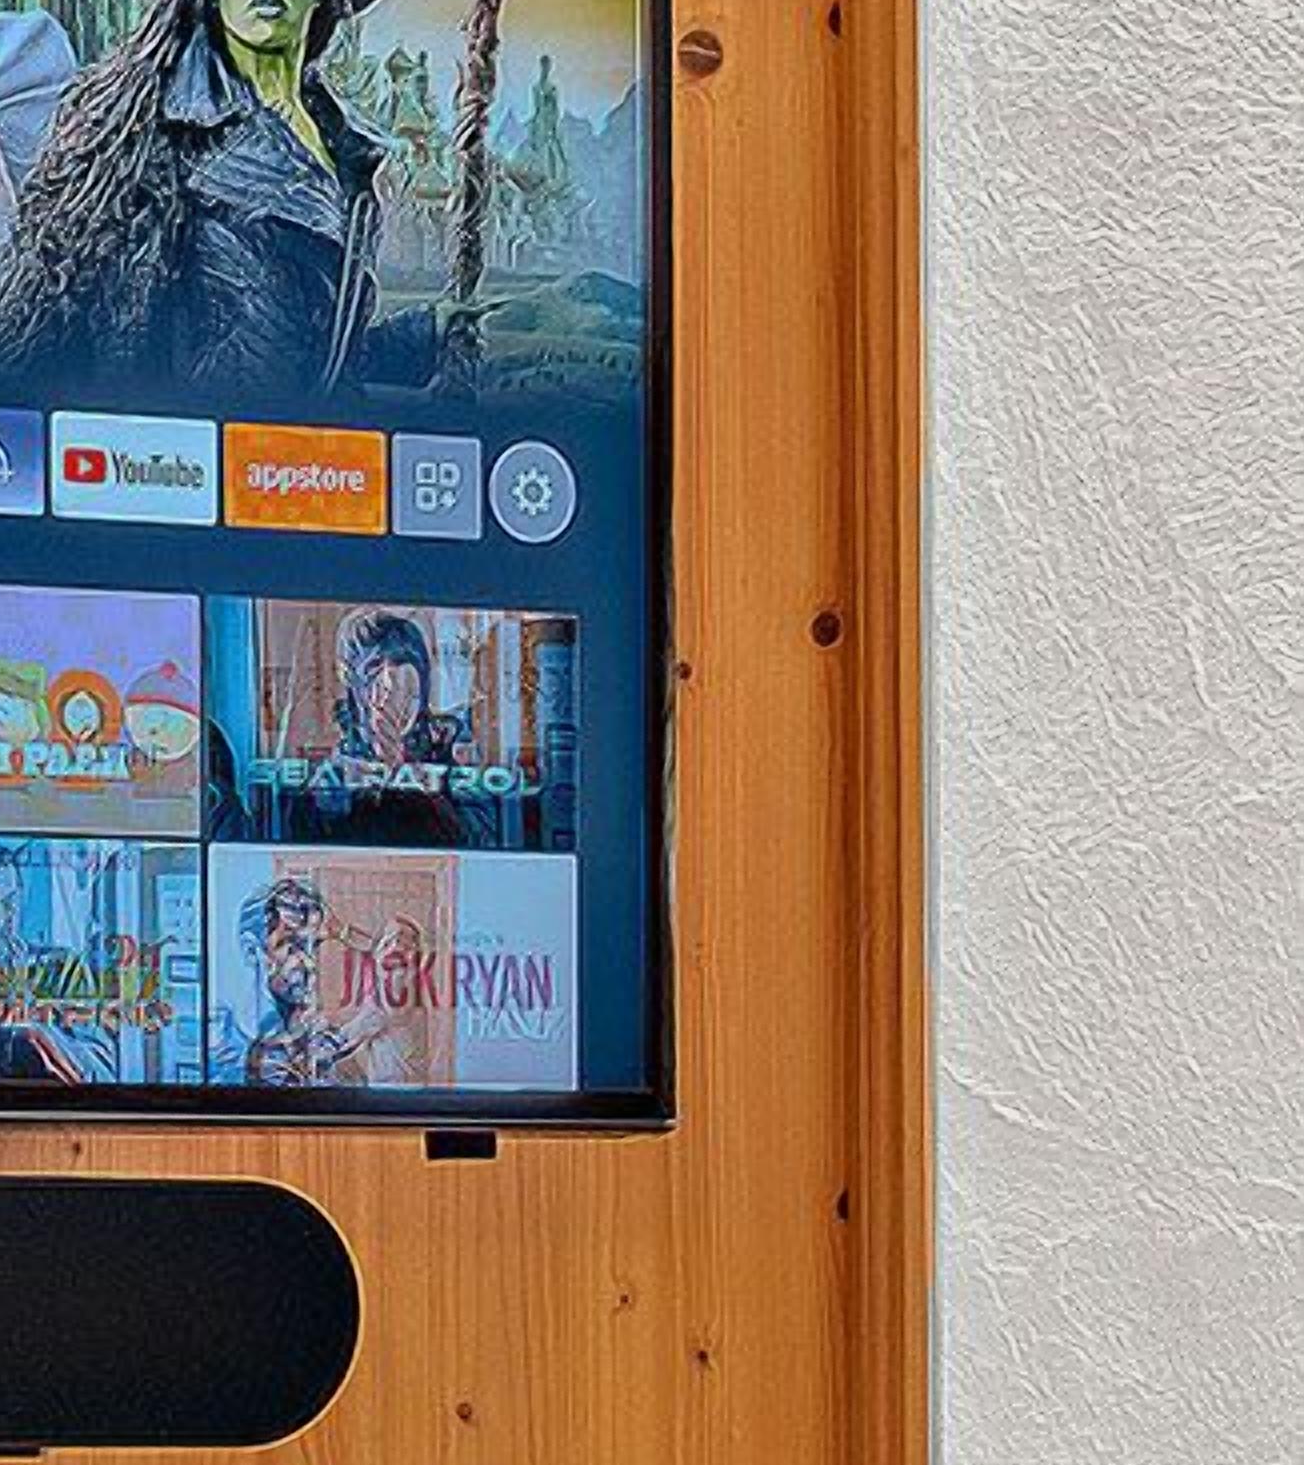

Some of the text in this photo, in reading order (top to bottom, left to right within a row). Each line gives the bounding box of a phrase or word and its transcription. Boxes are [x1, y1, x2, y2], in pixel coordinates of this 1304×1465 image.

[112, 447, 207, 491] YouTube
[246, 460, 367, 495] appstore
[339, 947, 554, 1012] JACK RYAN
